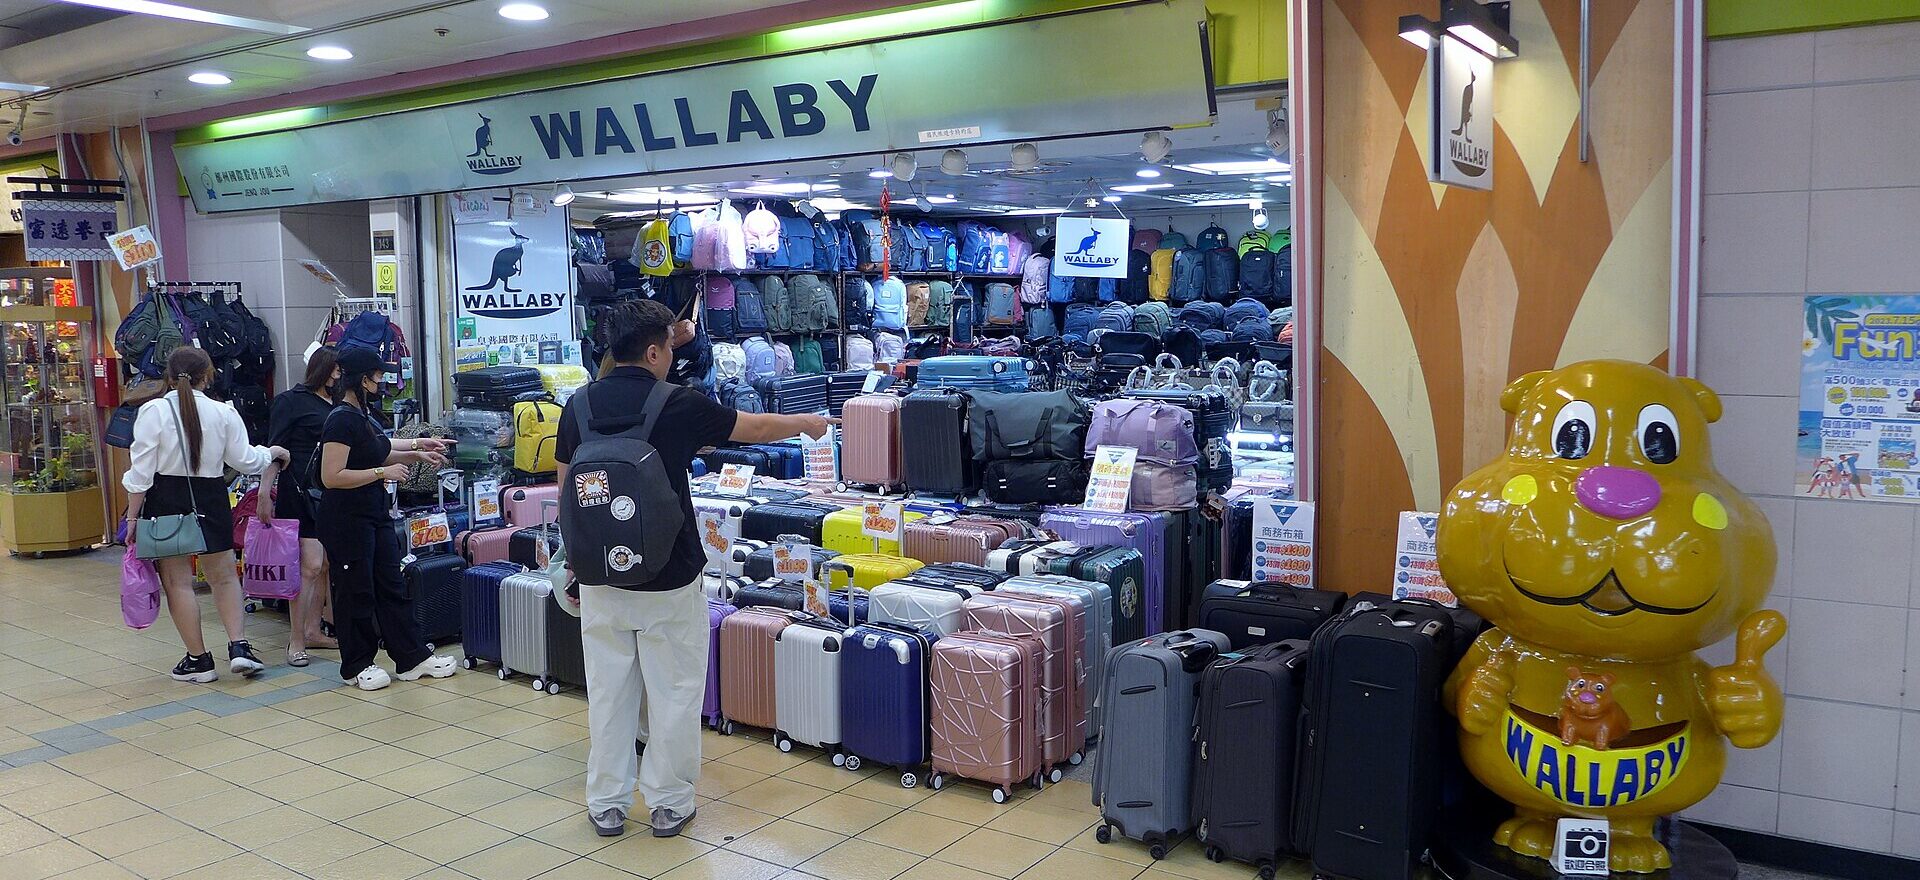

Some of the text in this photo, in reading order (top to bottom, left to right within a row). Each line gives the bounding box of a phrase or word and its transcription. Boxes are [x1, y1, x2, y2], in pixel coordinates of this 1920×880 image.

[530, 74, 879, 160] WALLABY
[1450, 139, 1489, 167] WALLABY
[466, 155, 523, 170] WALLABY
[1063, 255, 1120, 264] WALLABY
[462, 293, 567, 309] WALLABY
[1833, 322, 1913, 360] Fun
[411, 524, 448, 549] $749
[1261, 526, 1304, 540] 商務布箱
[1280, 544, 1311, 557] $1380
[776, 559, 809, 574] $1099
[1280, 559, 1311, 571] $1680
[1280, 573, 1310, 586] $1980
[1507, 717, 1685, 807] WALLABY
[1564, 859, 1607, 872] 歡迎合照
